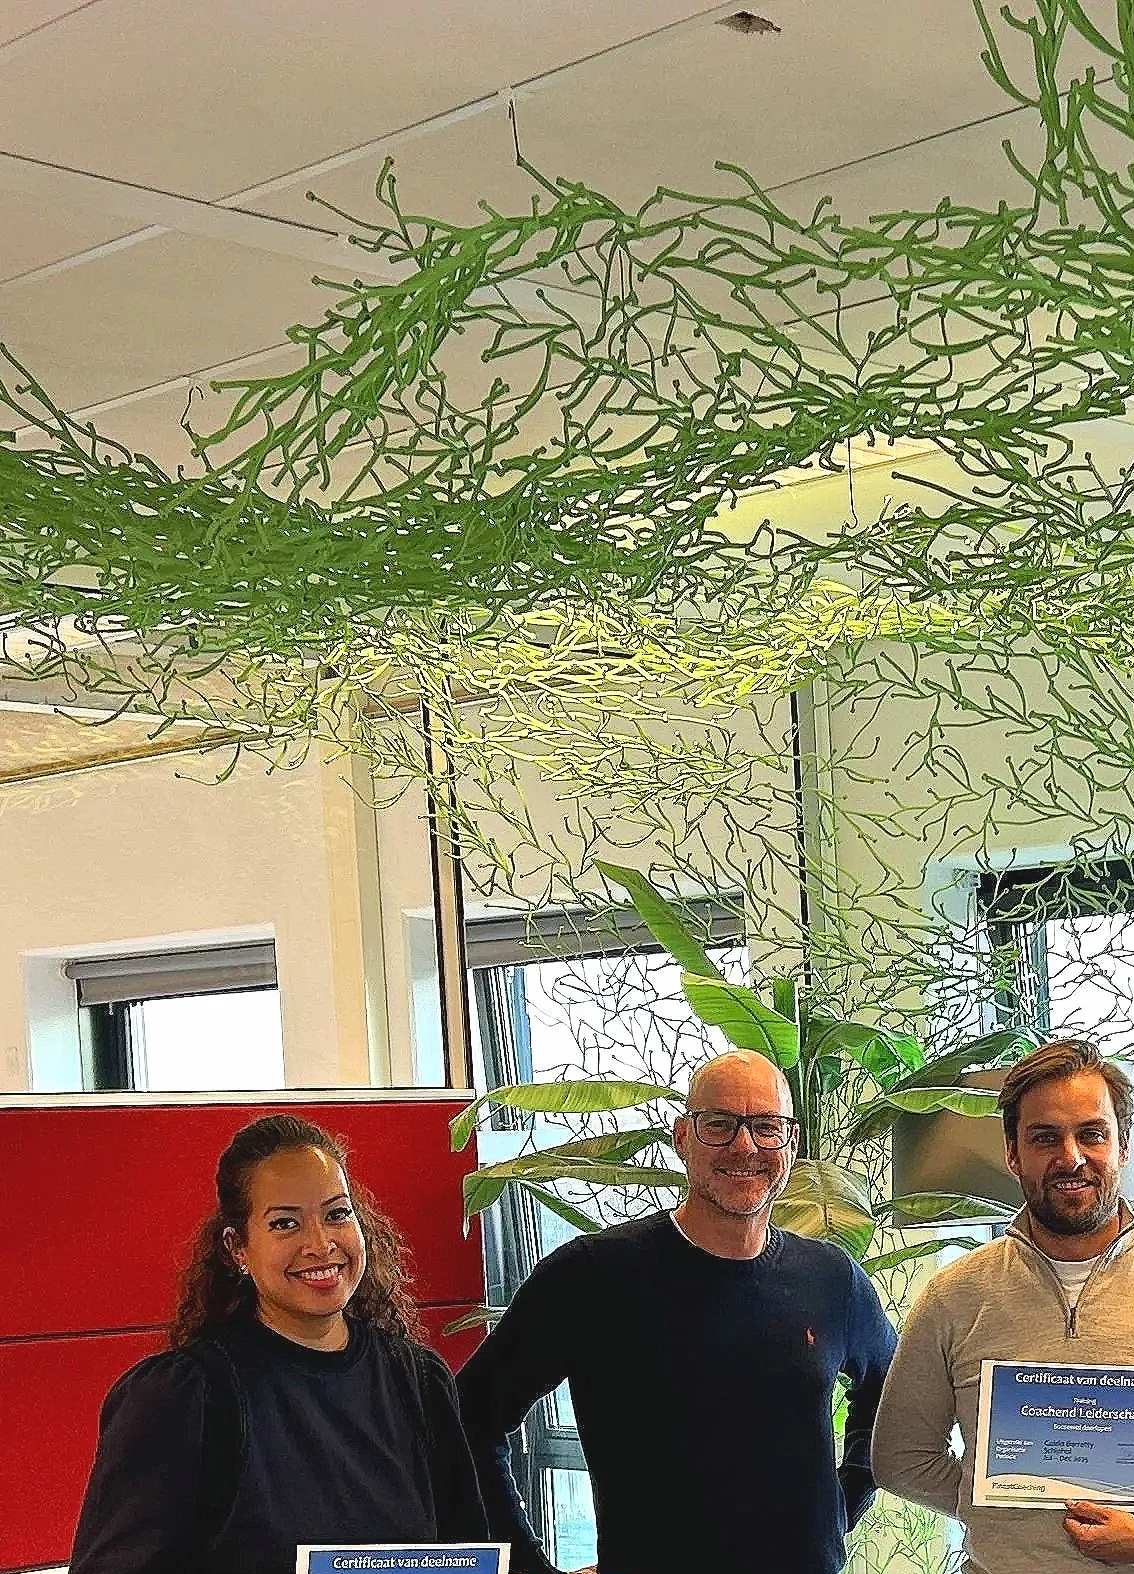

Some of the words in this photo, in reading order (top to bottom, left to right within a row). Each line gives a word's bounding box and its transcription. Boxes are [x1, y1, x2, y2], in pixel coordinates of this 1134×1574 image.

[1015, 1372, 1075, 1385] Certificaat
[1077, 1376, 1097, 1385] van
[1021, 1405, 1077, 1418] Coachend
[333, 1556, 395, 1569] Certificaat
[399, 1558, 418, 1568] van
[420, 1555, 477, 1567] deelname
